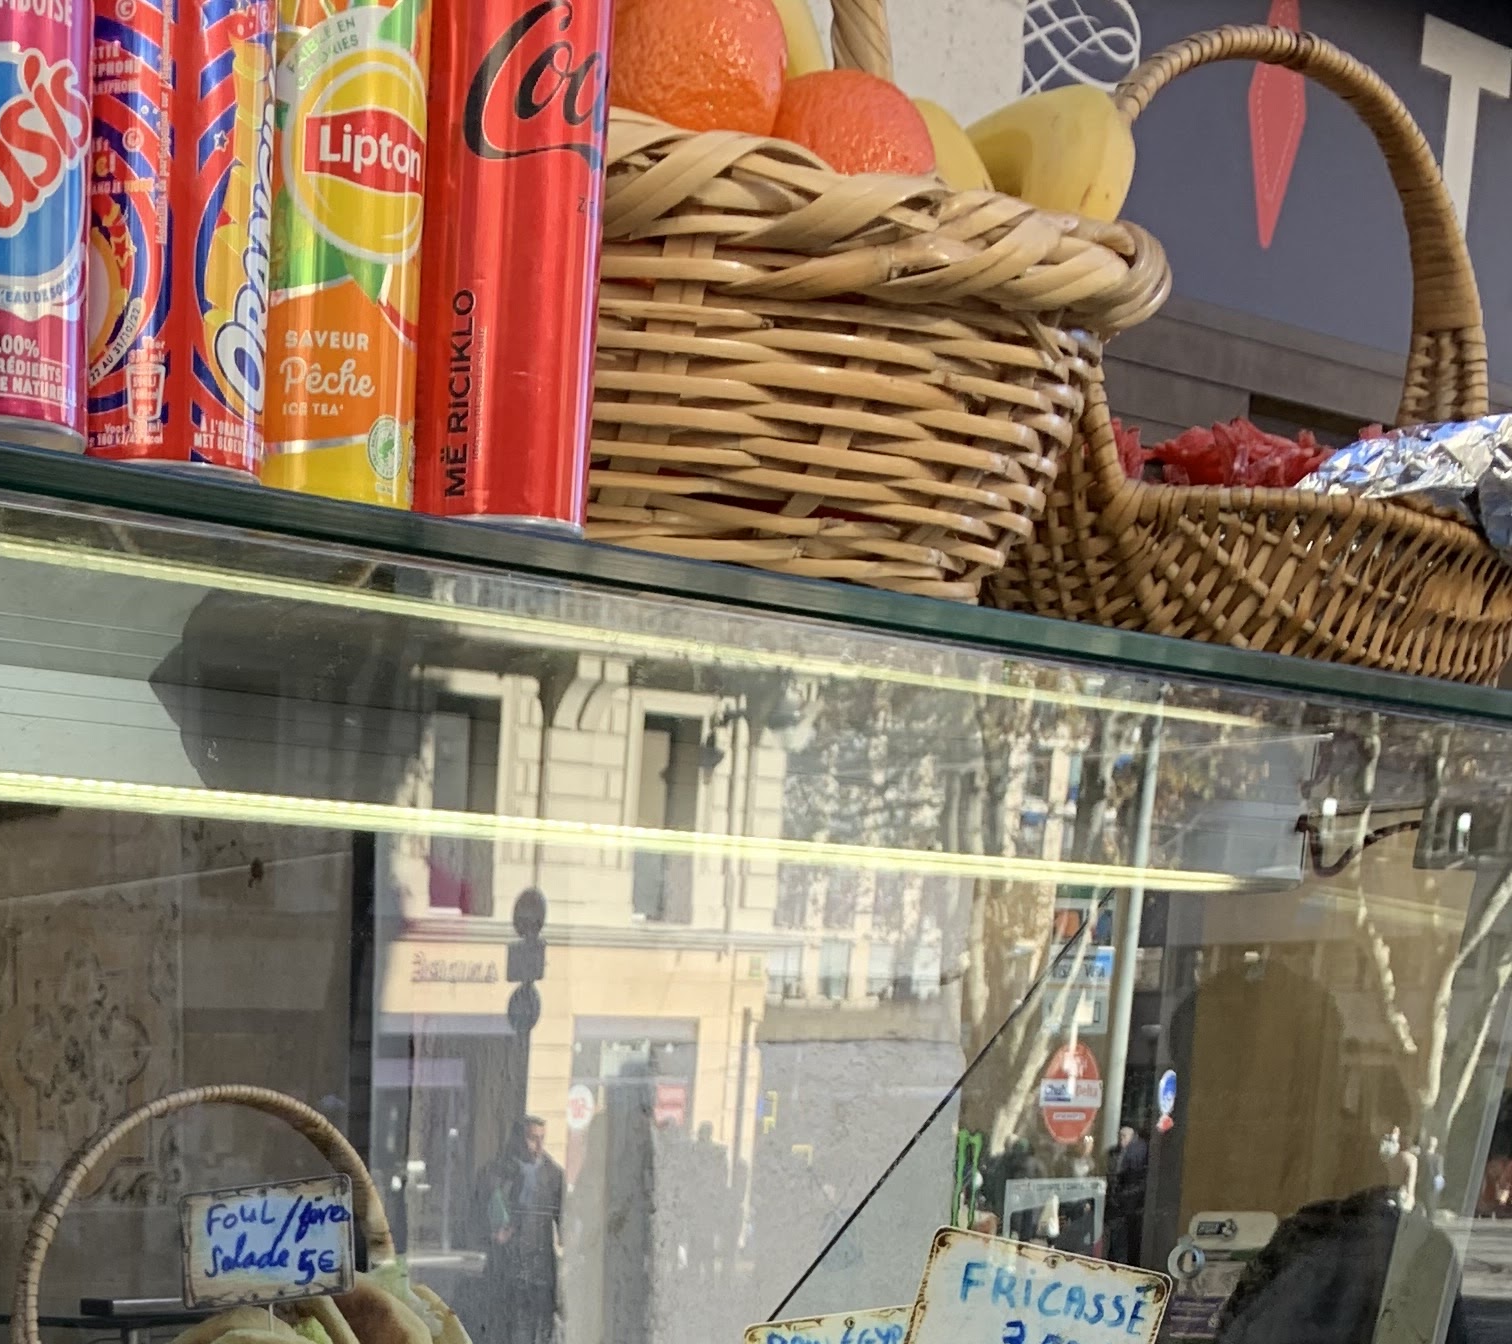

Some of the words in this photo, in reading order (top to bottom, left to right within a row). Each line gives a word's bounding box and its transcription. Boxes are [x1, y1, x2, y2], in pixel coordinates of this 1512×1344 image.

[336, 16, 356, 33] EN
[319, 123, 421, 183] Lipton
[285, 329, 369, 352] SAVEUR
[448, 289, 476, 434] RICIKLO
[279, 356, 376, 398] Pêche
[282, 402, 308, 416] ICE
[440, 443, 467, 497] MË
